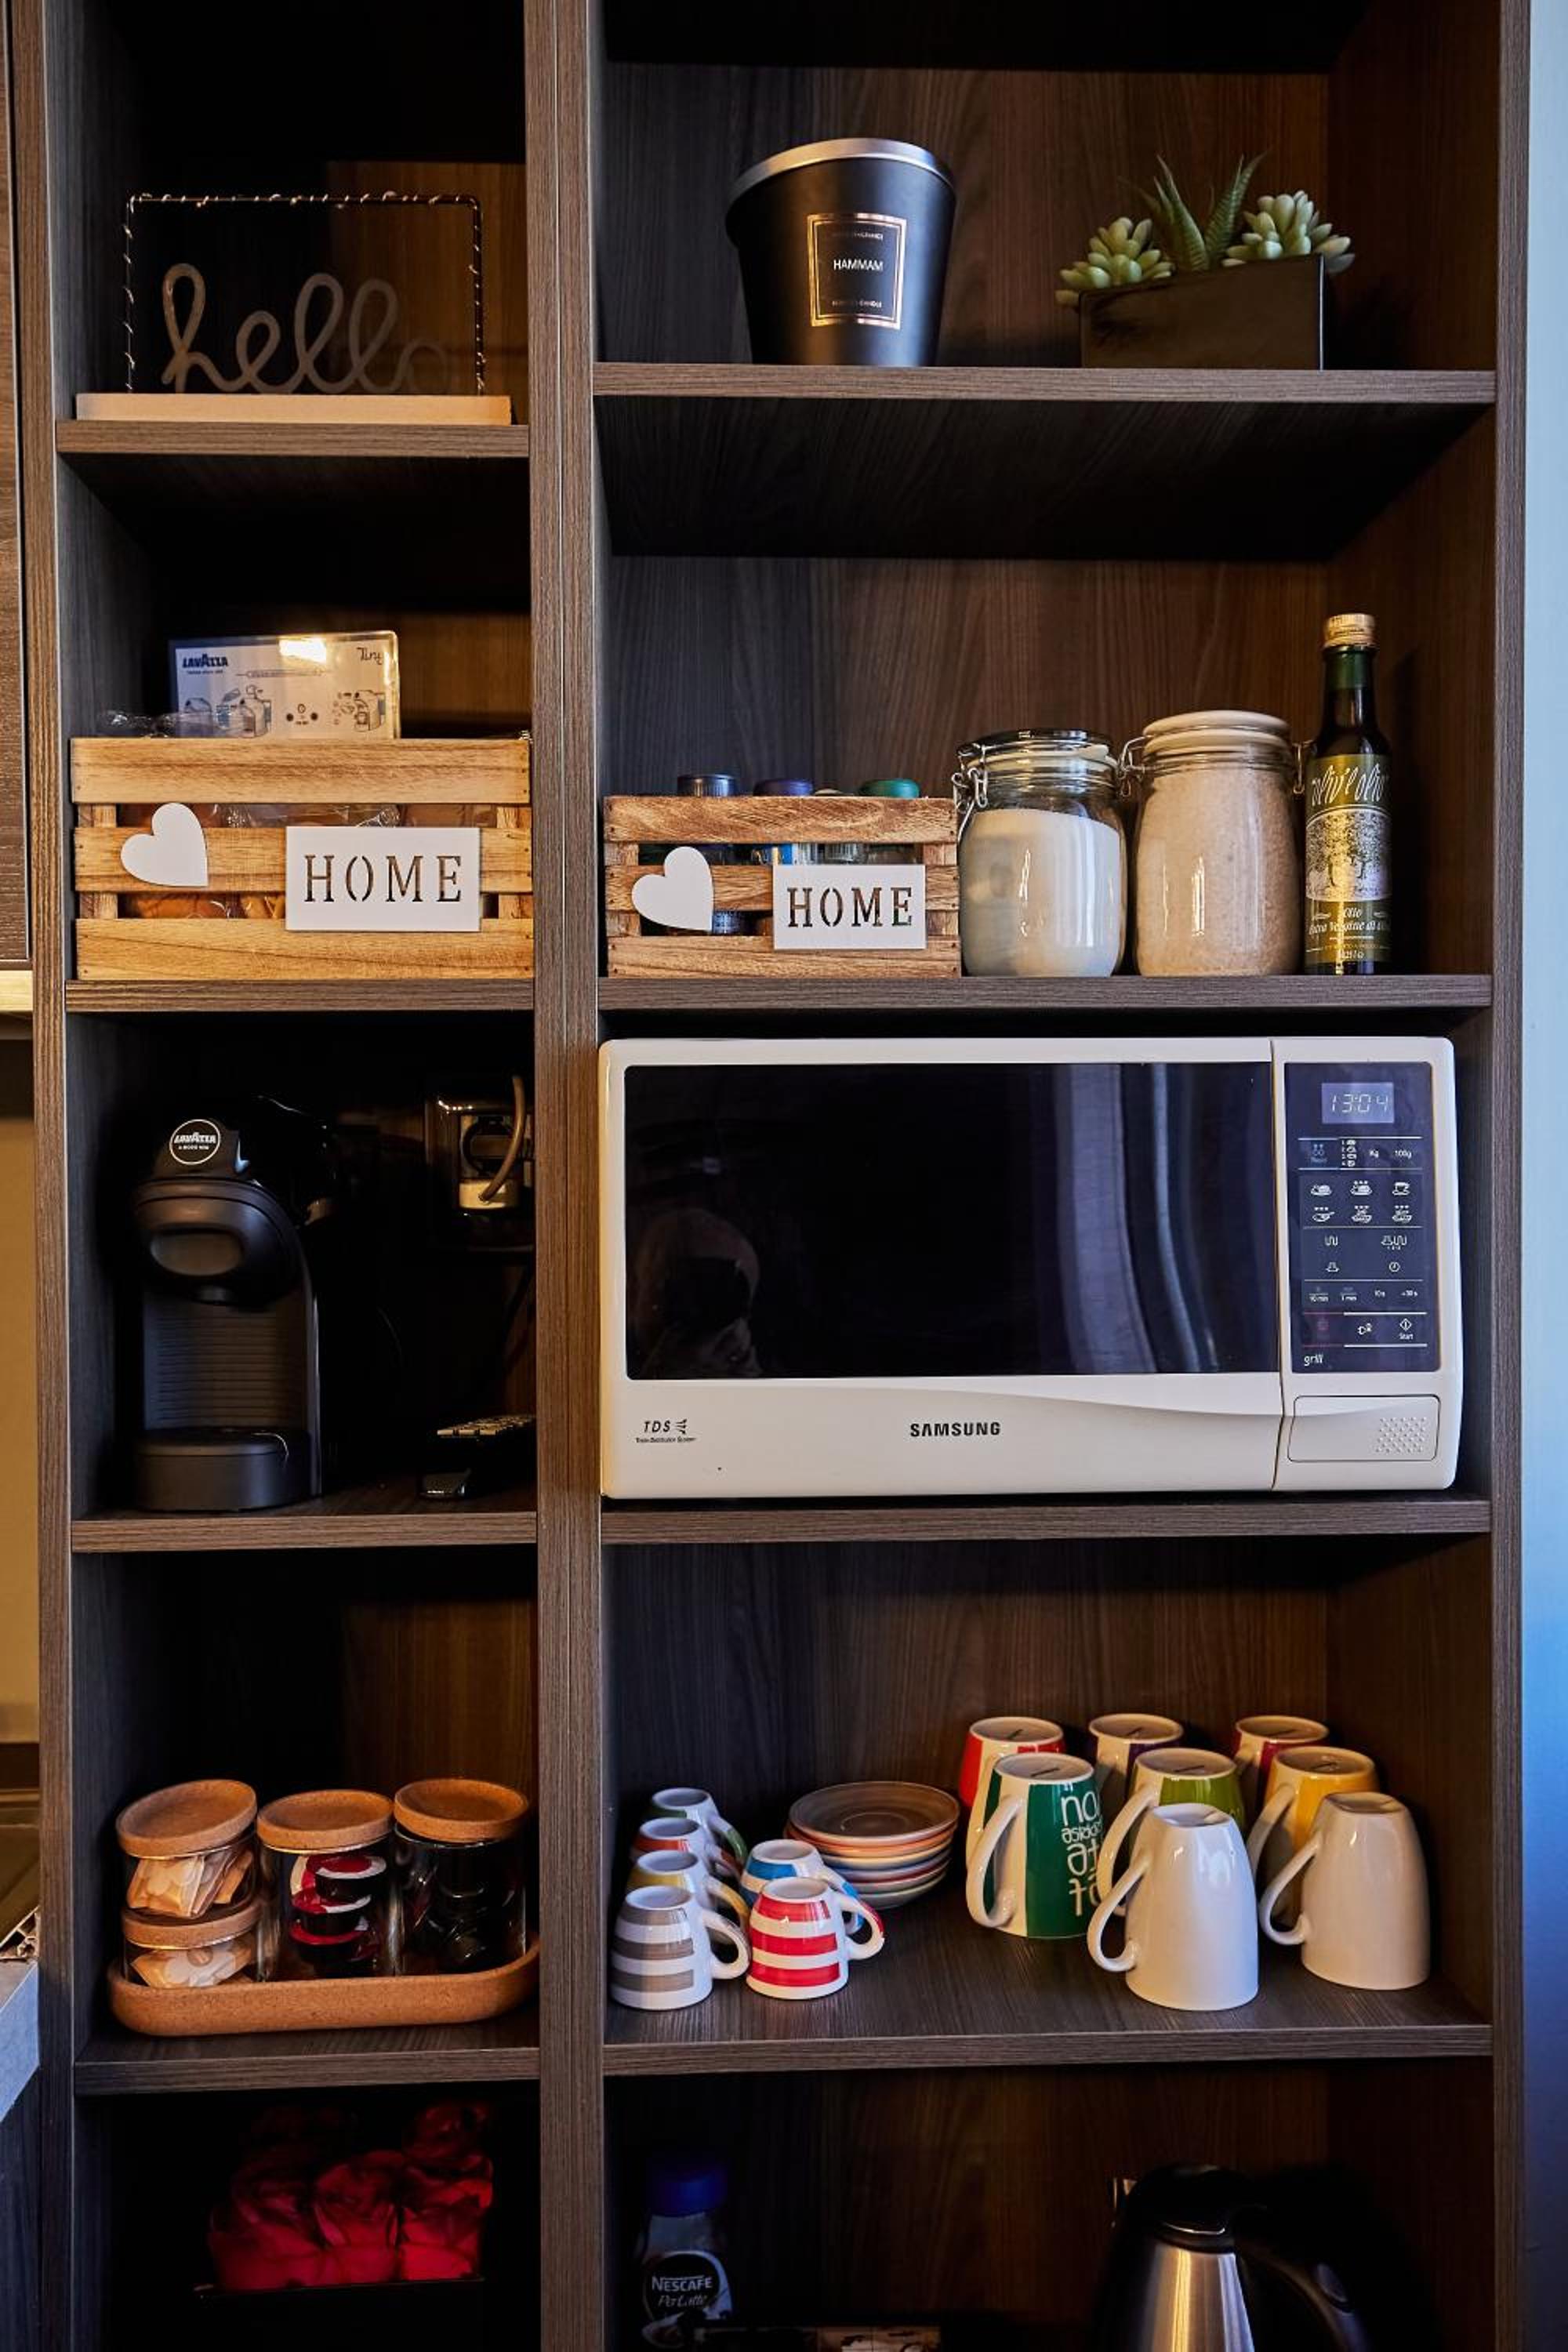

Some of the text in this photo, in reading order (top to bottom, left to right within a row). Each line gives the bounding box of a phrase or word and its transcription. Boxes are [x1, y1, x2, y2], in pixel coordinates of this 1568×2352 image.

[833, 260, 884, 271] HAMMAM
[162, 263, 452, 393] hello
[182, 653, 229, 668] LAVAZZA
[303, 855, 462, 902] HOME
[786, 886, 913, 927] HOME
[1332, 1094, 1388, 1112] 13:04
[173, 1131, 216, 1144] LAVAZZA
[1304, 1354, 1323, 1366] grill
[643, 1419, 671, 1433] TDS
[909, 1421, 1000, 1436] SAMSUNG
